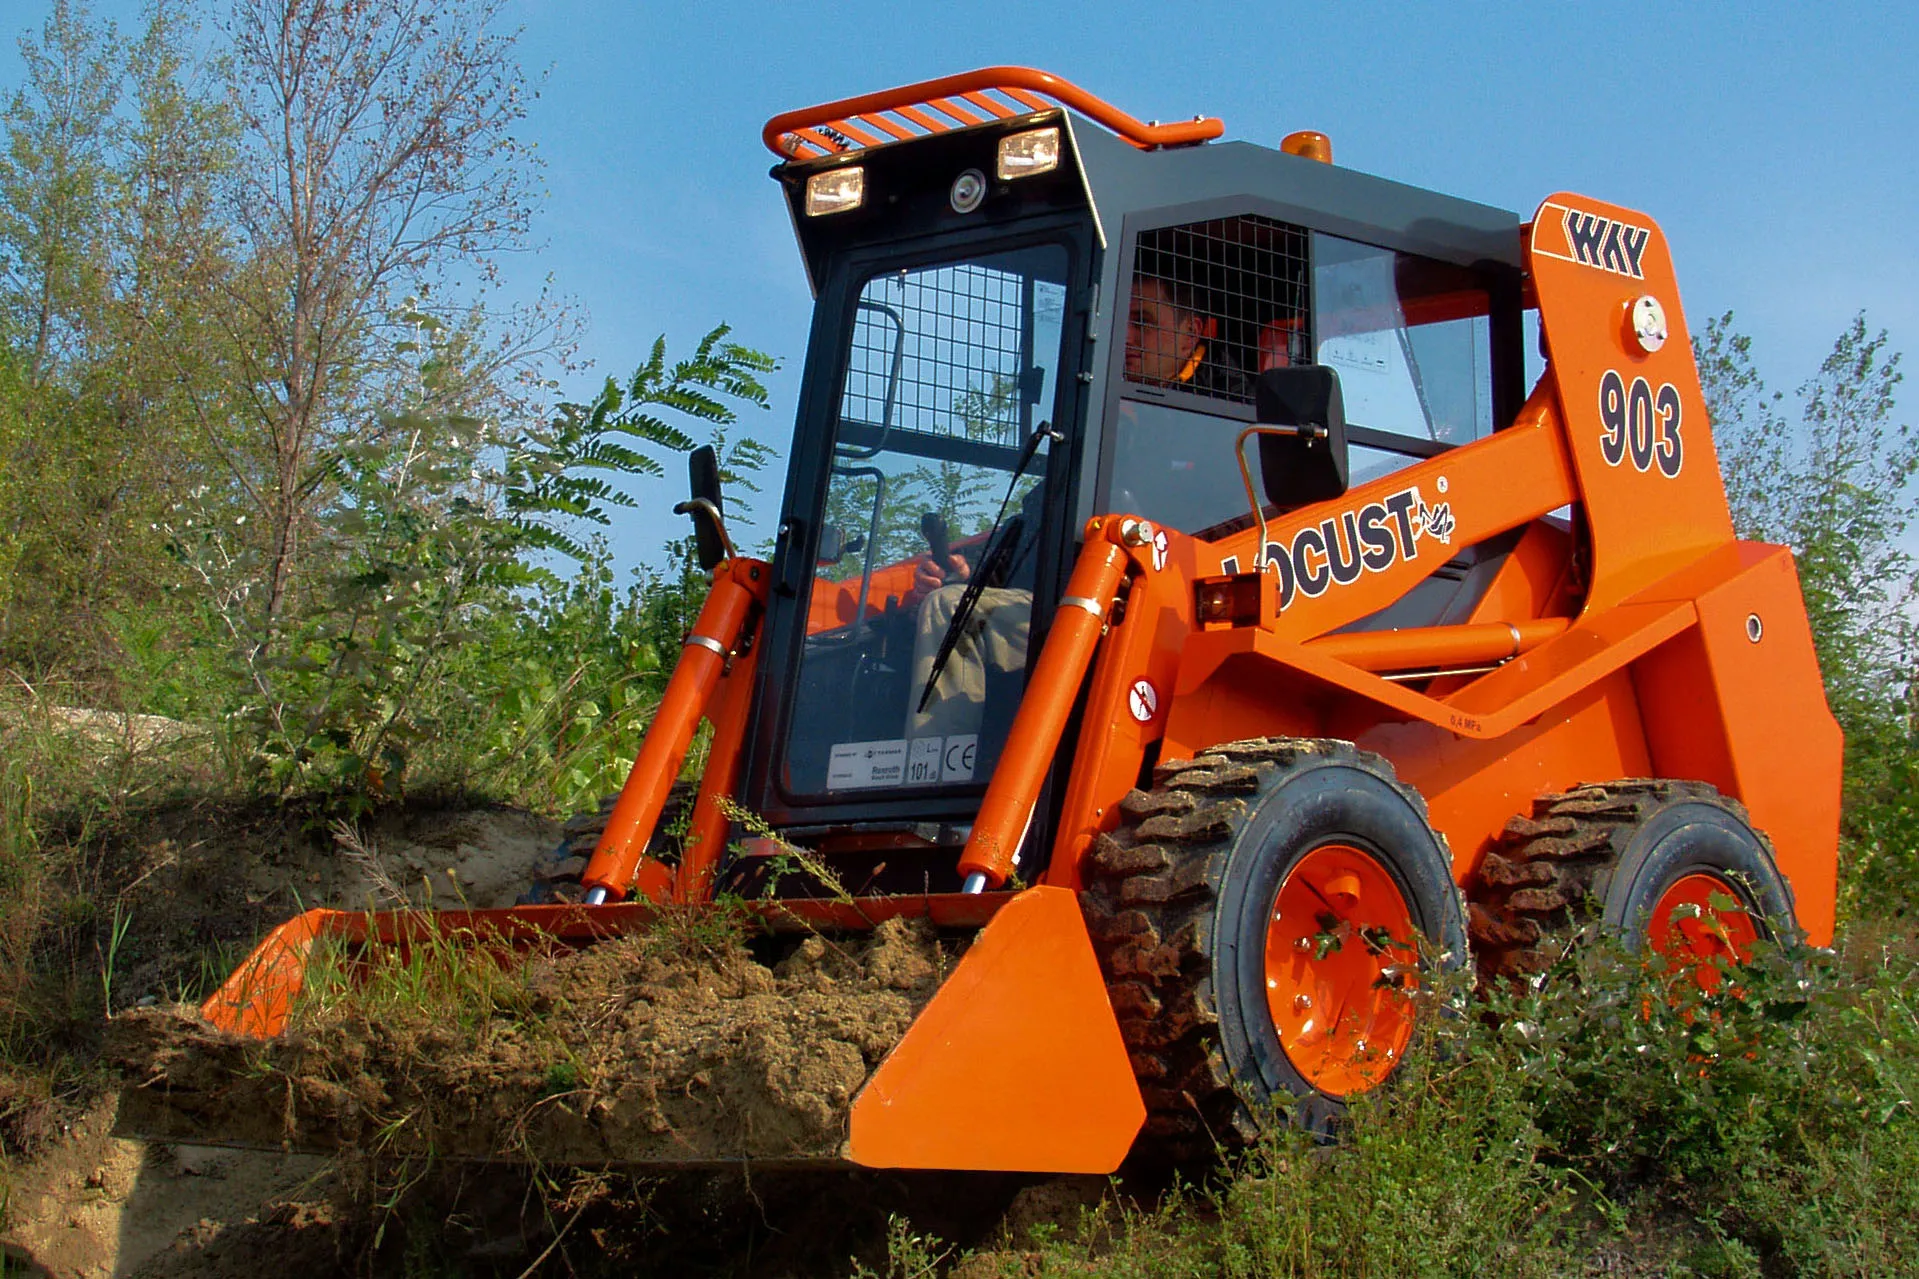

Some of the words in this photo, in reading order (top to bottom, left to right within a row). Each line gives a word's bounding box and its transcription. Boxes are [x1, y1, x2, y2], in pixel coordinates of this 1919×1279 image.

[1567, 209, 1650, 280] WAY
[1599, 369, 1683, 479] 903
[1221, 487, 1420, 612] OCUST
[910, 762, 928, 781] 101
[946, 744, 975, 771] CE
